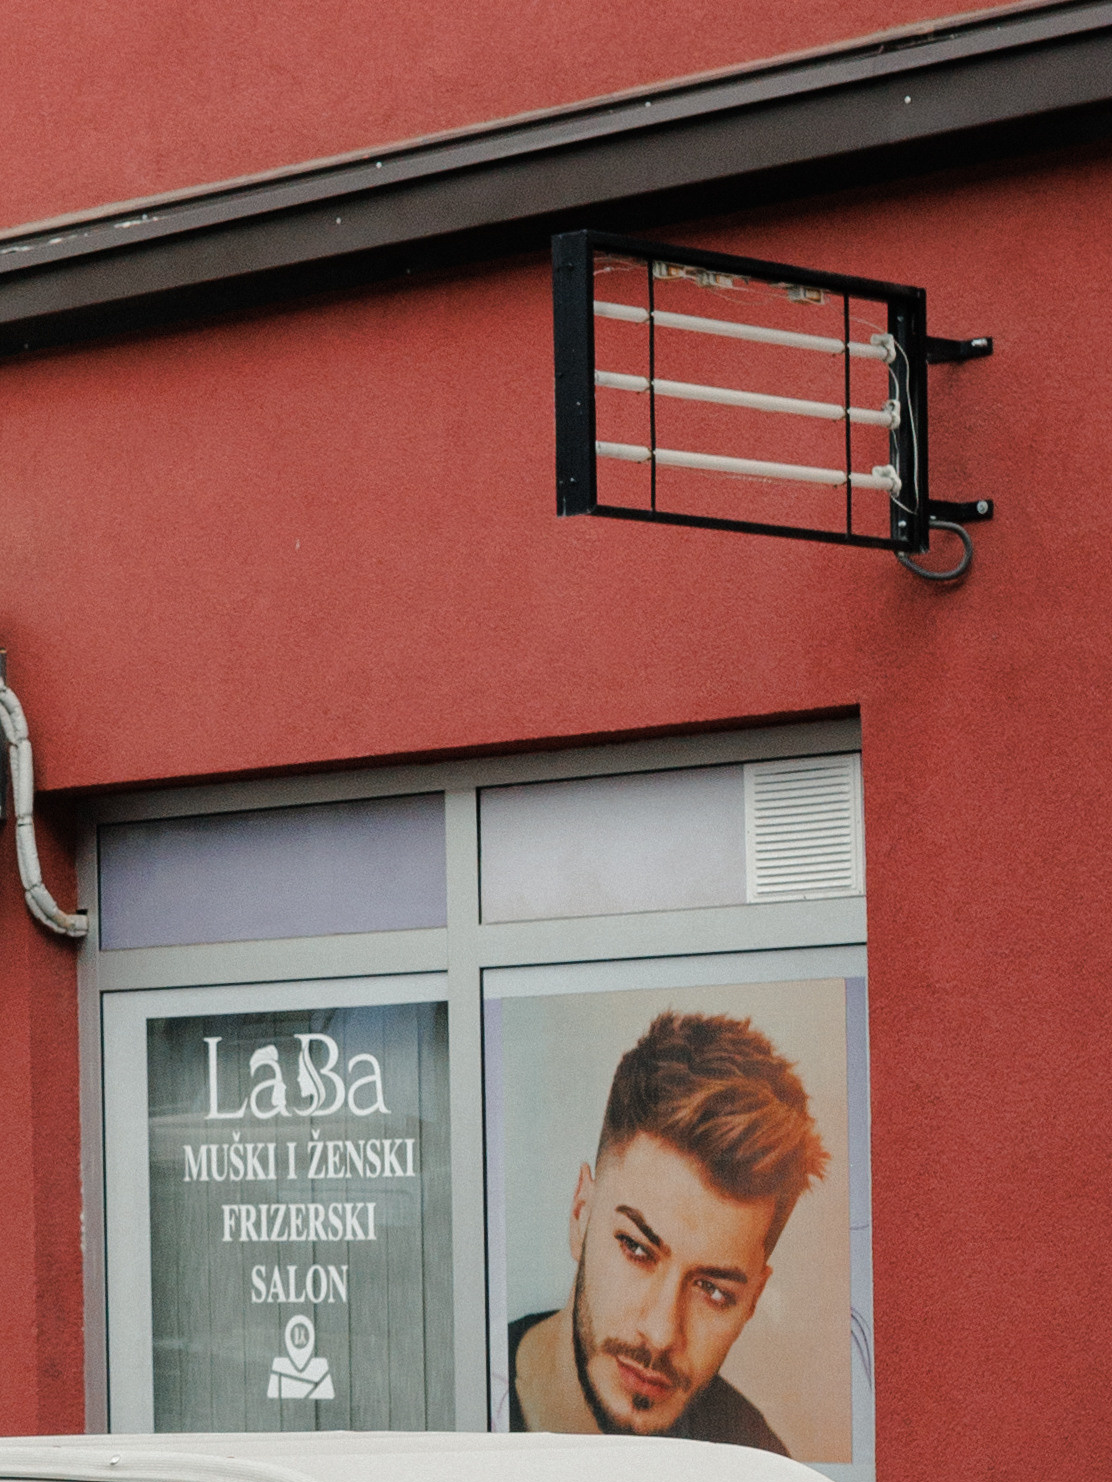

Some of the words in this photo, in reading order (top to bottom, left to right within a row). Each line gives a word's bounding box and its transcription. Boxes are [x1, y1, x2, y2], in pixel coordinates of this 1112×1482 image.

[203, 1032, 392, 1120] LaBa
[183, 1131, 277, 1182] MUŠKI
[286, 1141, 298, 1180] I
[307, 1128, 416, 1179] ŽENSKI
[221, 1202, 377, 1242] FRIZERSKI
[250, 1265, 349, 1304] SALON
